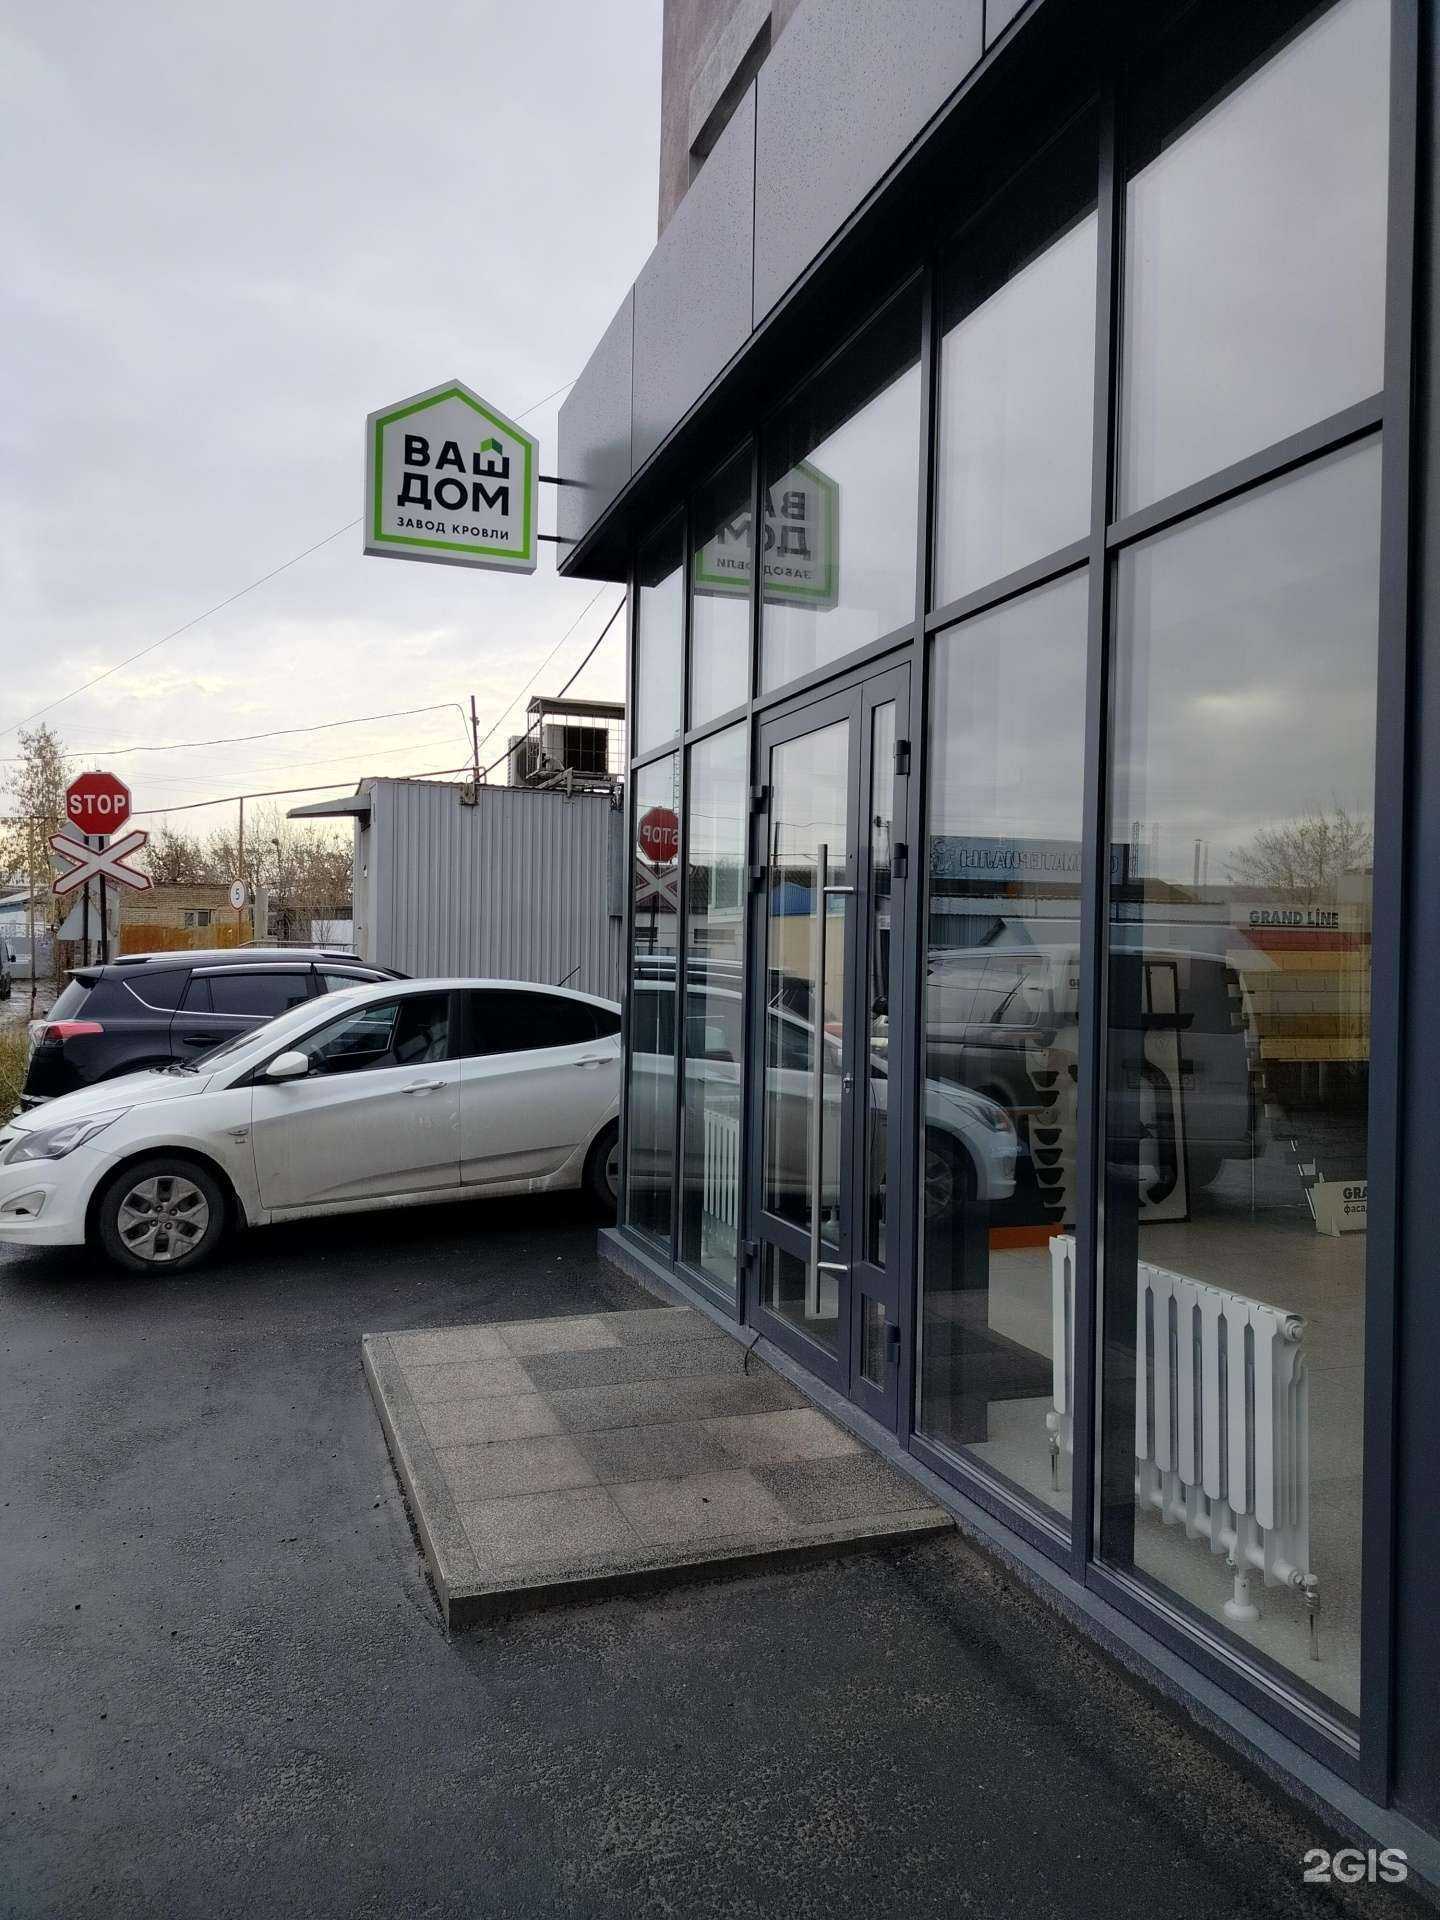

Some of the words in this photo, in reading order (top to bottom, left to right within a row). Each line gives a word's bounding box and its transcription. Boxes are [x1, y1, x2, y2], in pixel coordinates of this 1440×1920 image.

[404, 434, 510, 480] ВАШ
[397, 471, 510, 517] ДОМ
[396, 516, 446, 534] ЗАВОД
[452, 524, 510, 541] КРОВЛИ
[70, 794, 126, 815] STOP
[235, 888, 241, 901] 5
[1249, 910, 1303, 924] GRAND
[1308, 908, 1339, 925] LINE
